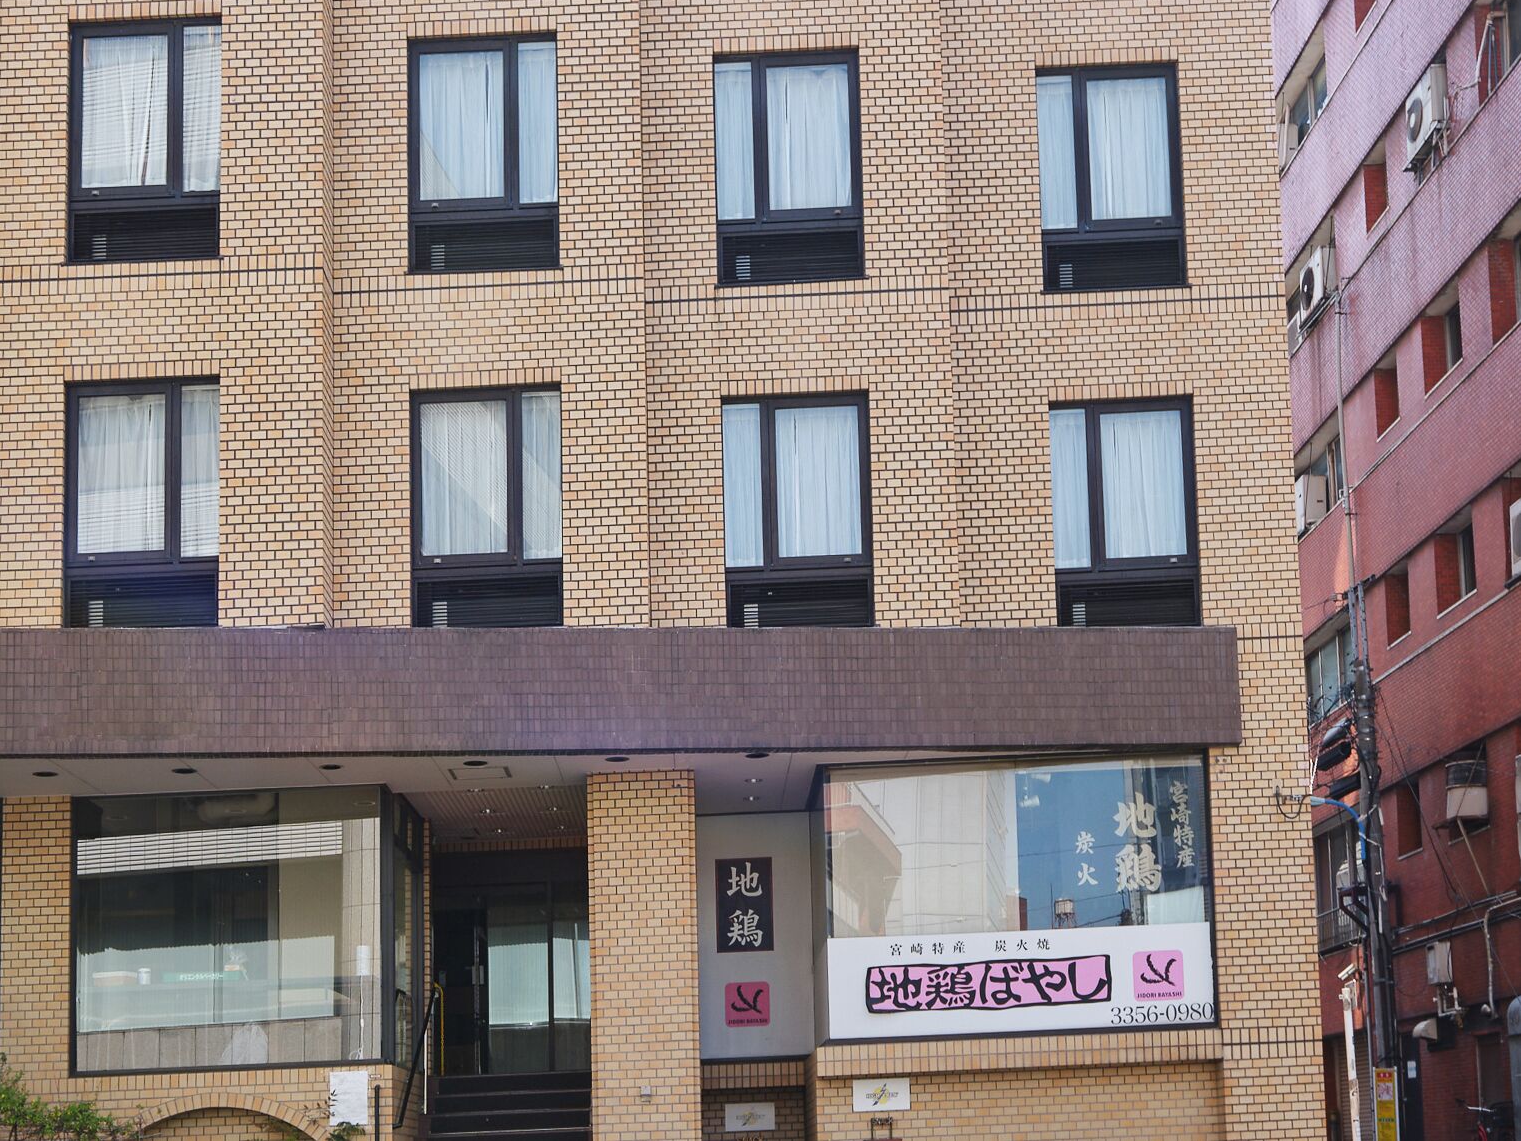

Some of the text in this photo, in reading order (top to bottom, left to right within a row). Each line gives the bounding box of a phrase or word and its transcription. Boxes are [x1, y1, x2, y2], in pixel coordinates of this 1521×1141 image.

[1113, 791, 1162, 892] 地鶏
[1169, 781, 1195, 868] 宮崎特産
[1075, 831, 1098, 886] 炭火
[726, 861, 763, 947] 地鶏
[889, 938, 1051, 956] 宮崎特産 炭火焼
[870, 959, 1109, 1010] 地鶏ばやし
[1110, 1002, 1214, 1026] 3356-0980
